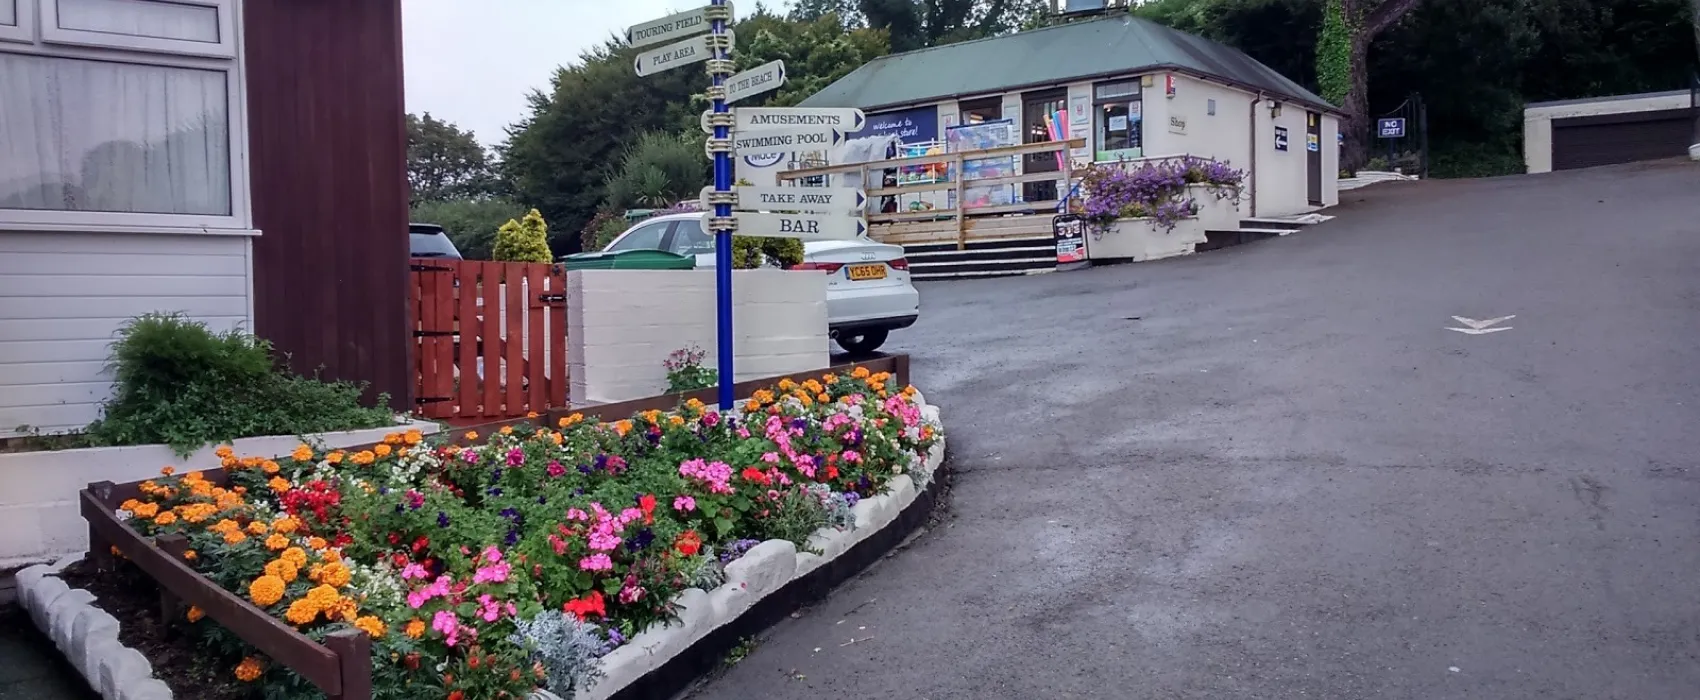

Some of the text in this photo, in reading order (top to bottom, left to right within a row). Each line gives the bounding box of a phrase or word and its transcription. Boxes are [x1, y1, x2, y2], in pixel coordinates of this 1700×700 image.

[636, 15, 702, 40] TOURING FIELD
[652, 46, 696, 66] PLAY AREA
[729, 71, 773, 94] TO THE BEACH
[750, 114, 840, 125] AMUSEMENTS
[873, 117, 912, 130] welcome to
[1170, 116, 1186, 130] Shop
[1384, 120, 1398, 128] NO
[736, 133, 828, 149] SWIMMING POOL
[760, 193, 833, 204] TAKE AWAY
[780, 218, 820, 234] BAR
